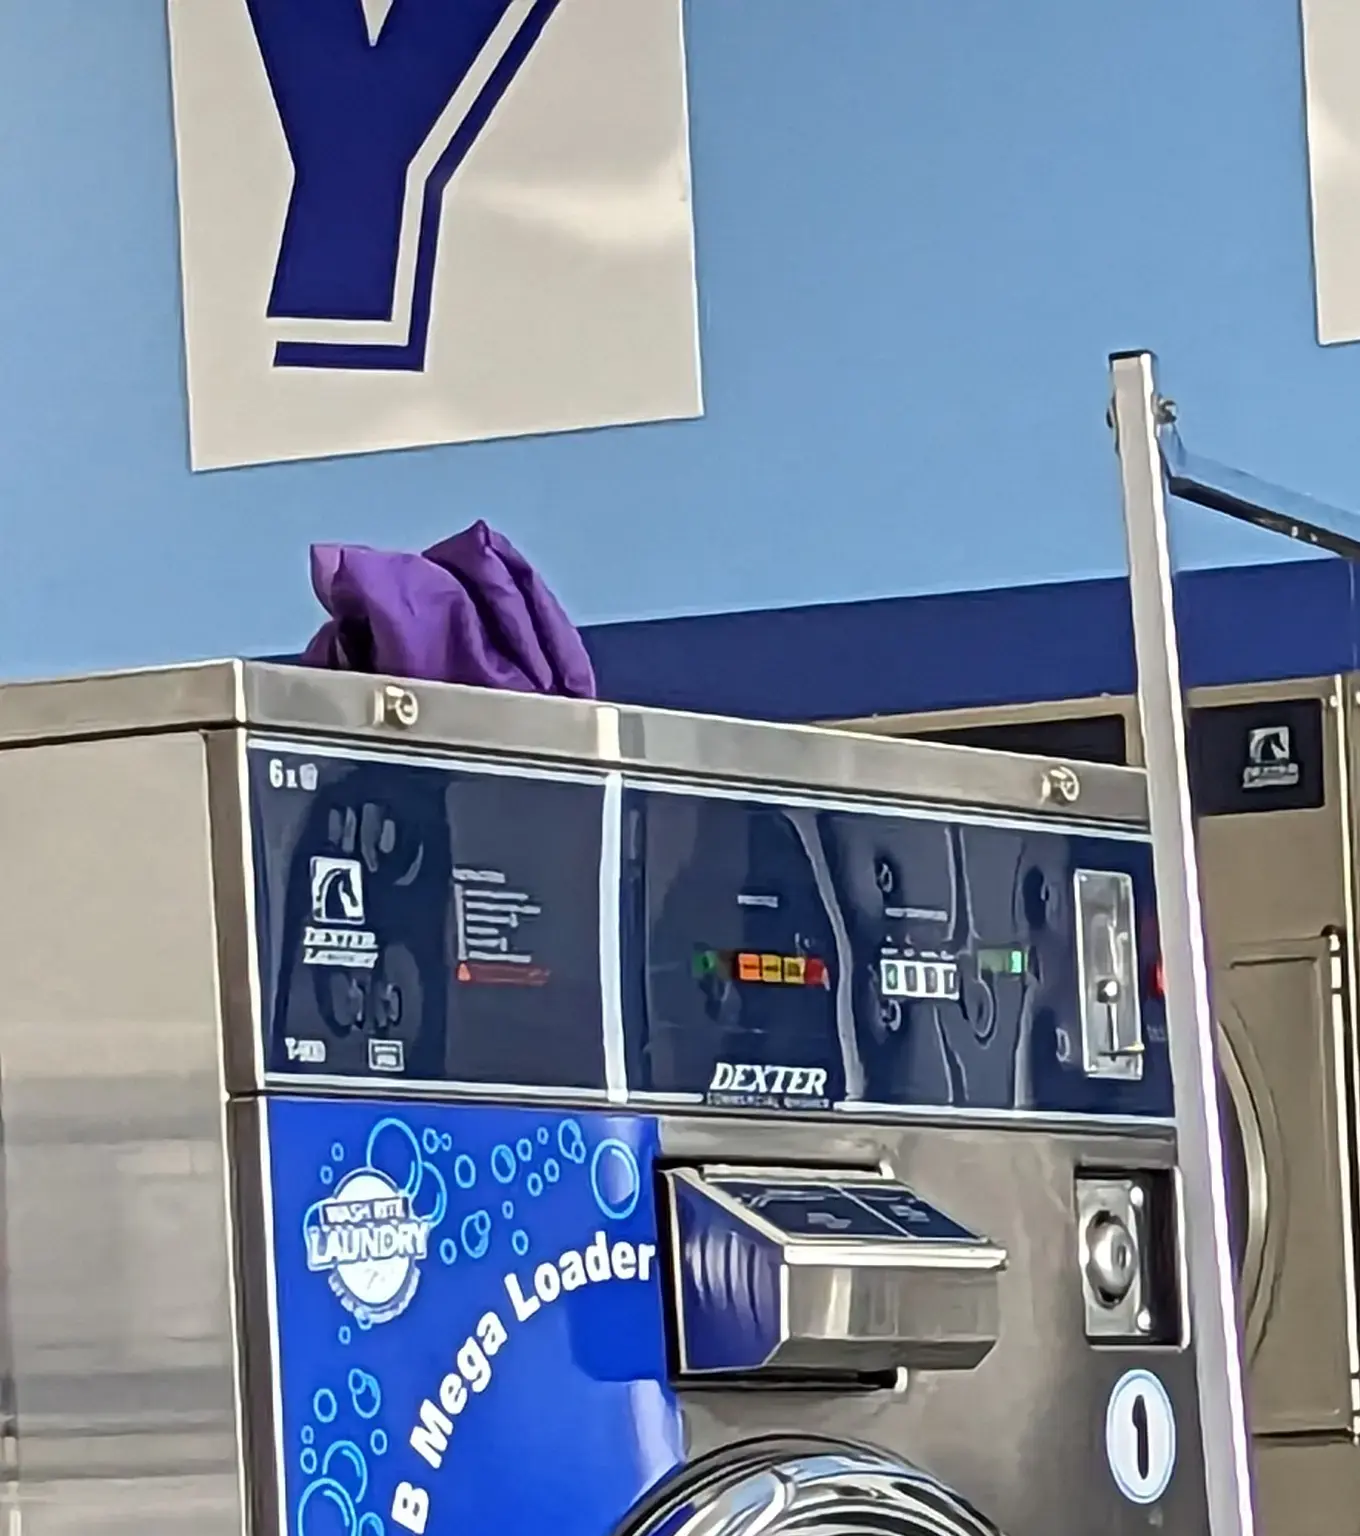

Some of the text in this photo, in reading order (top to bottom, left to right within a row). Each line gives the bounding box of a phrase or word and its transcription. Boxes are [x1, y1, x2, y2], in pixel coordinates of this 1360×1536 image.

[709, 1062, 828, 1096] DEXTER
[308, 1220, 428, 1266] LAUNDRY
[409, 1310, 508, 1469] Mega
[504, 1231, 655, 1322] Loader
[1131, 1393, 1150, 1481] 1
